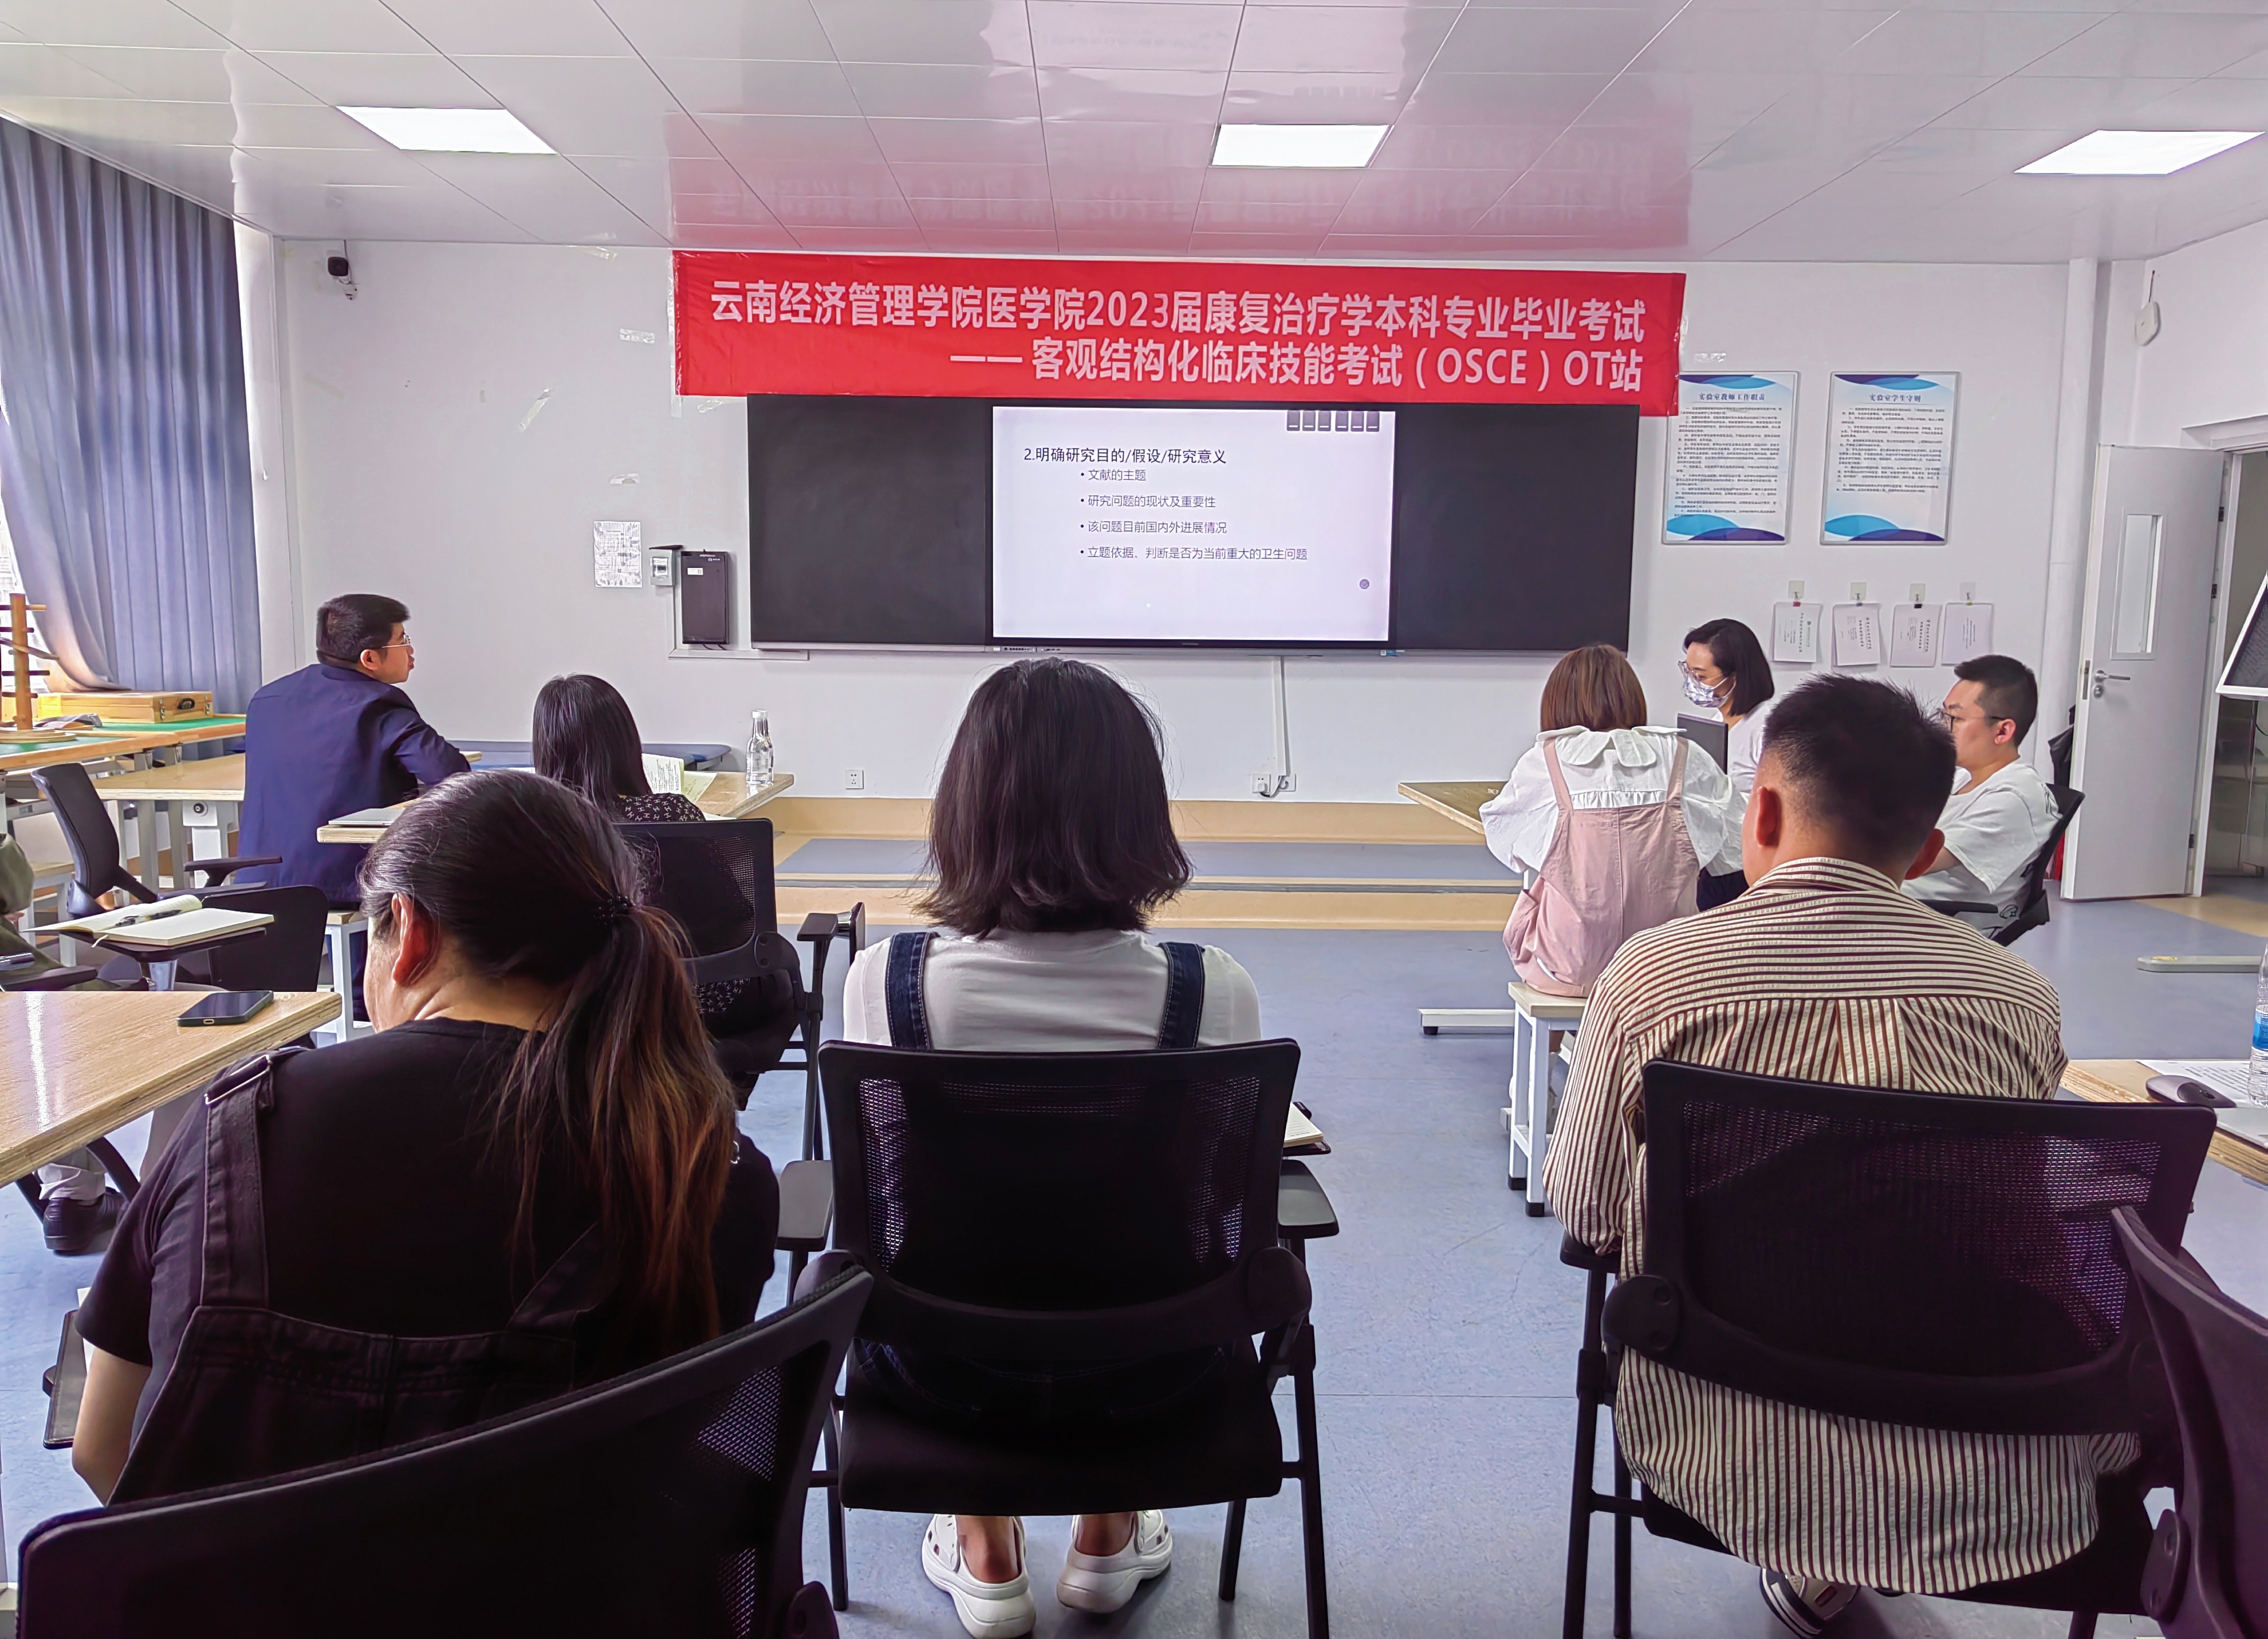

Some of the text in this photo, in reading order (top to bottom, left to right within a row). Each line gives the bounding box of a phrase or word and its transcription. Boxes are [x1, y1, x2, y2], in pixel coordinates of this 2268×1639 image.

[710, 280, 1645, 343] 云南经济管理学院医学院2023届康复治疗学本科专业毕业考试
[1024, 447, 1226, 464] 2.明确研究目的/假设/研究意义
[1088, 469, 1146, 481] 文献的主题
[1088, 495, 1216, 508] 研究问题的现状及重要性
[1088, 520, 1228, 534] 该问题目前国内外进展情况
